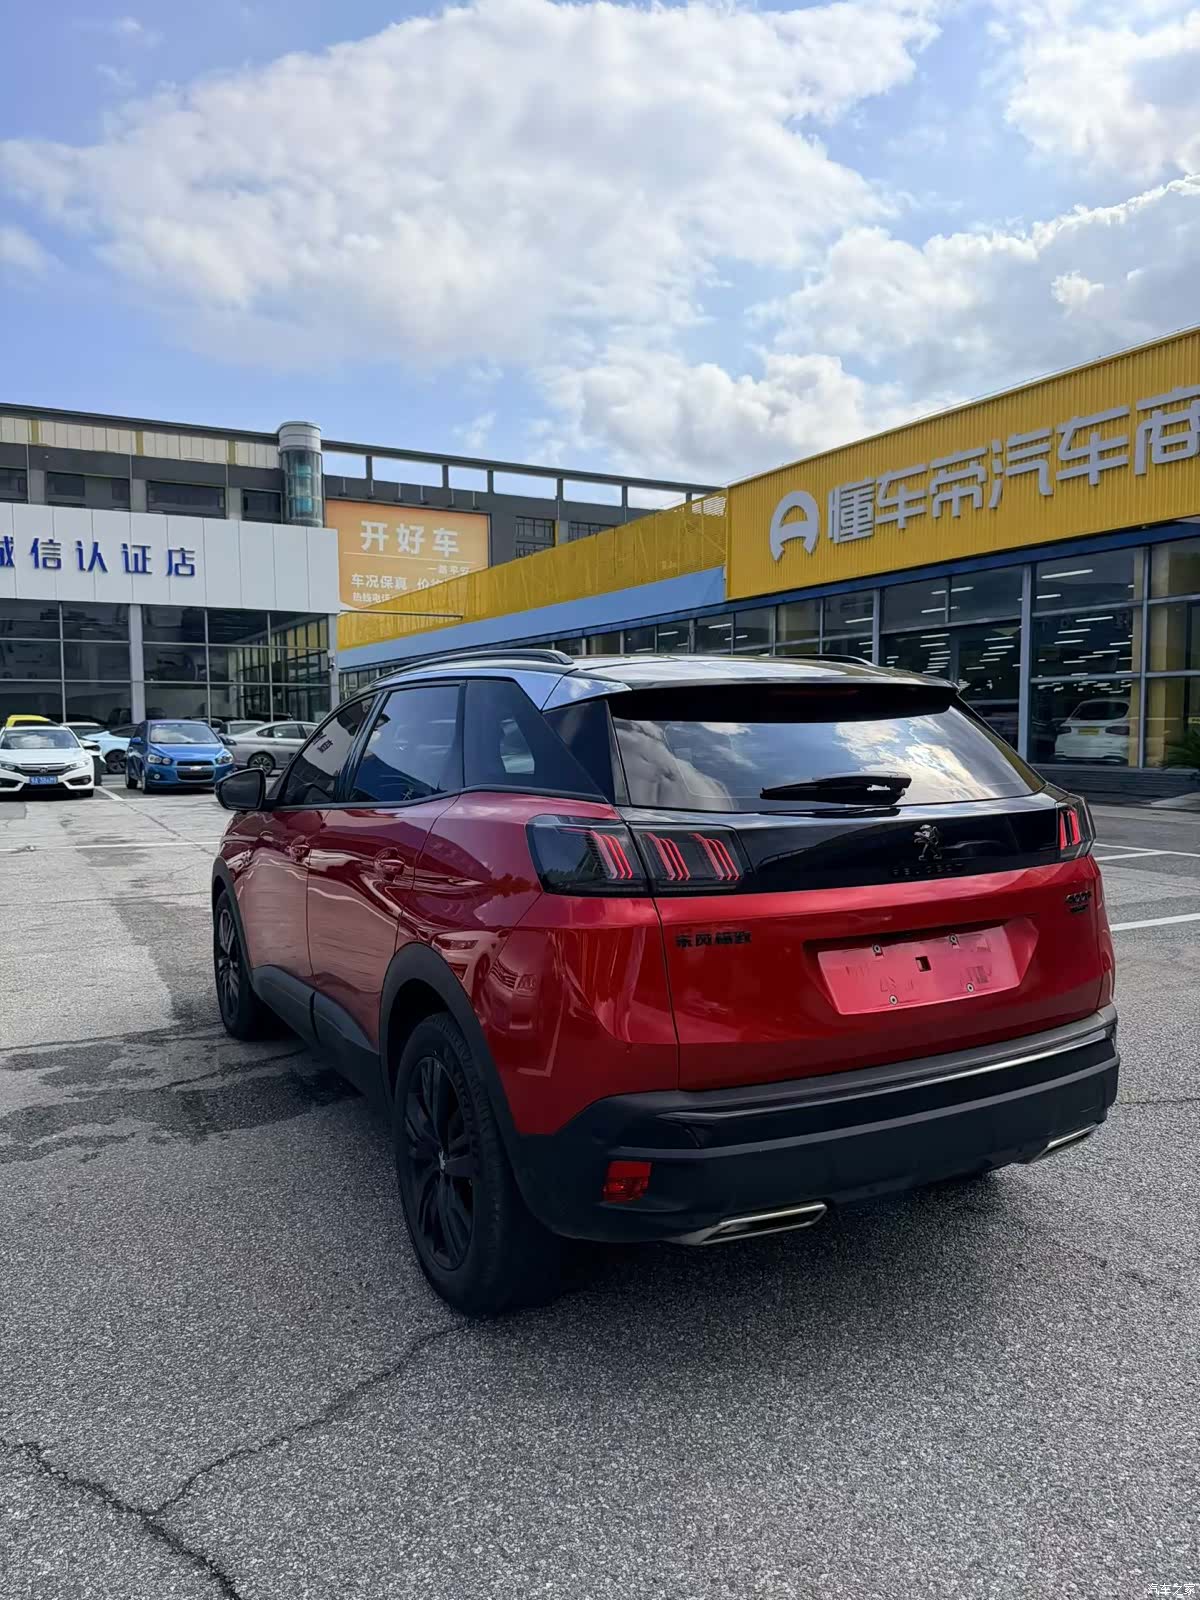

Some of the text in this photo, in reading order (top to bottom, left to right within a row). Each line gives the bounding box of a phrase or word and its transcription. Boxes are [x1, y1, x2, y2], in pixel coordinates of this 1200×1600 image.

[827, 384, 1200, 544] 懂车帝汽车商
[360, 520, 460, 557] 开好车
[351, 573, 408, 590] 车况保真
